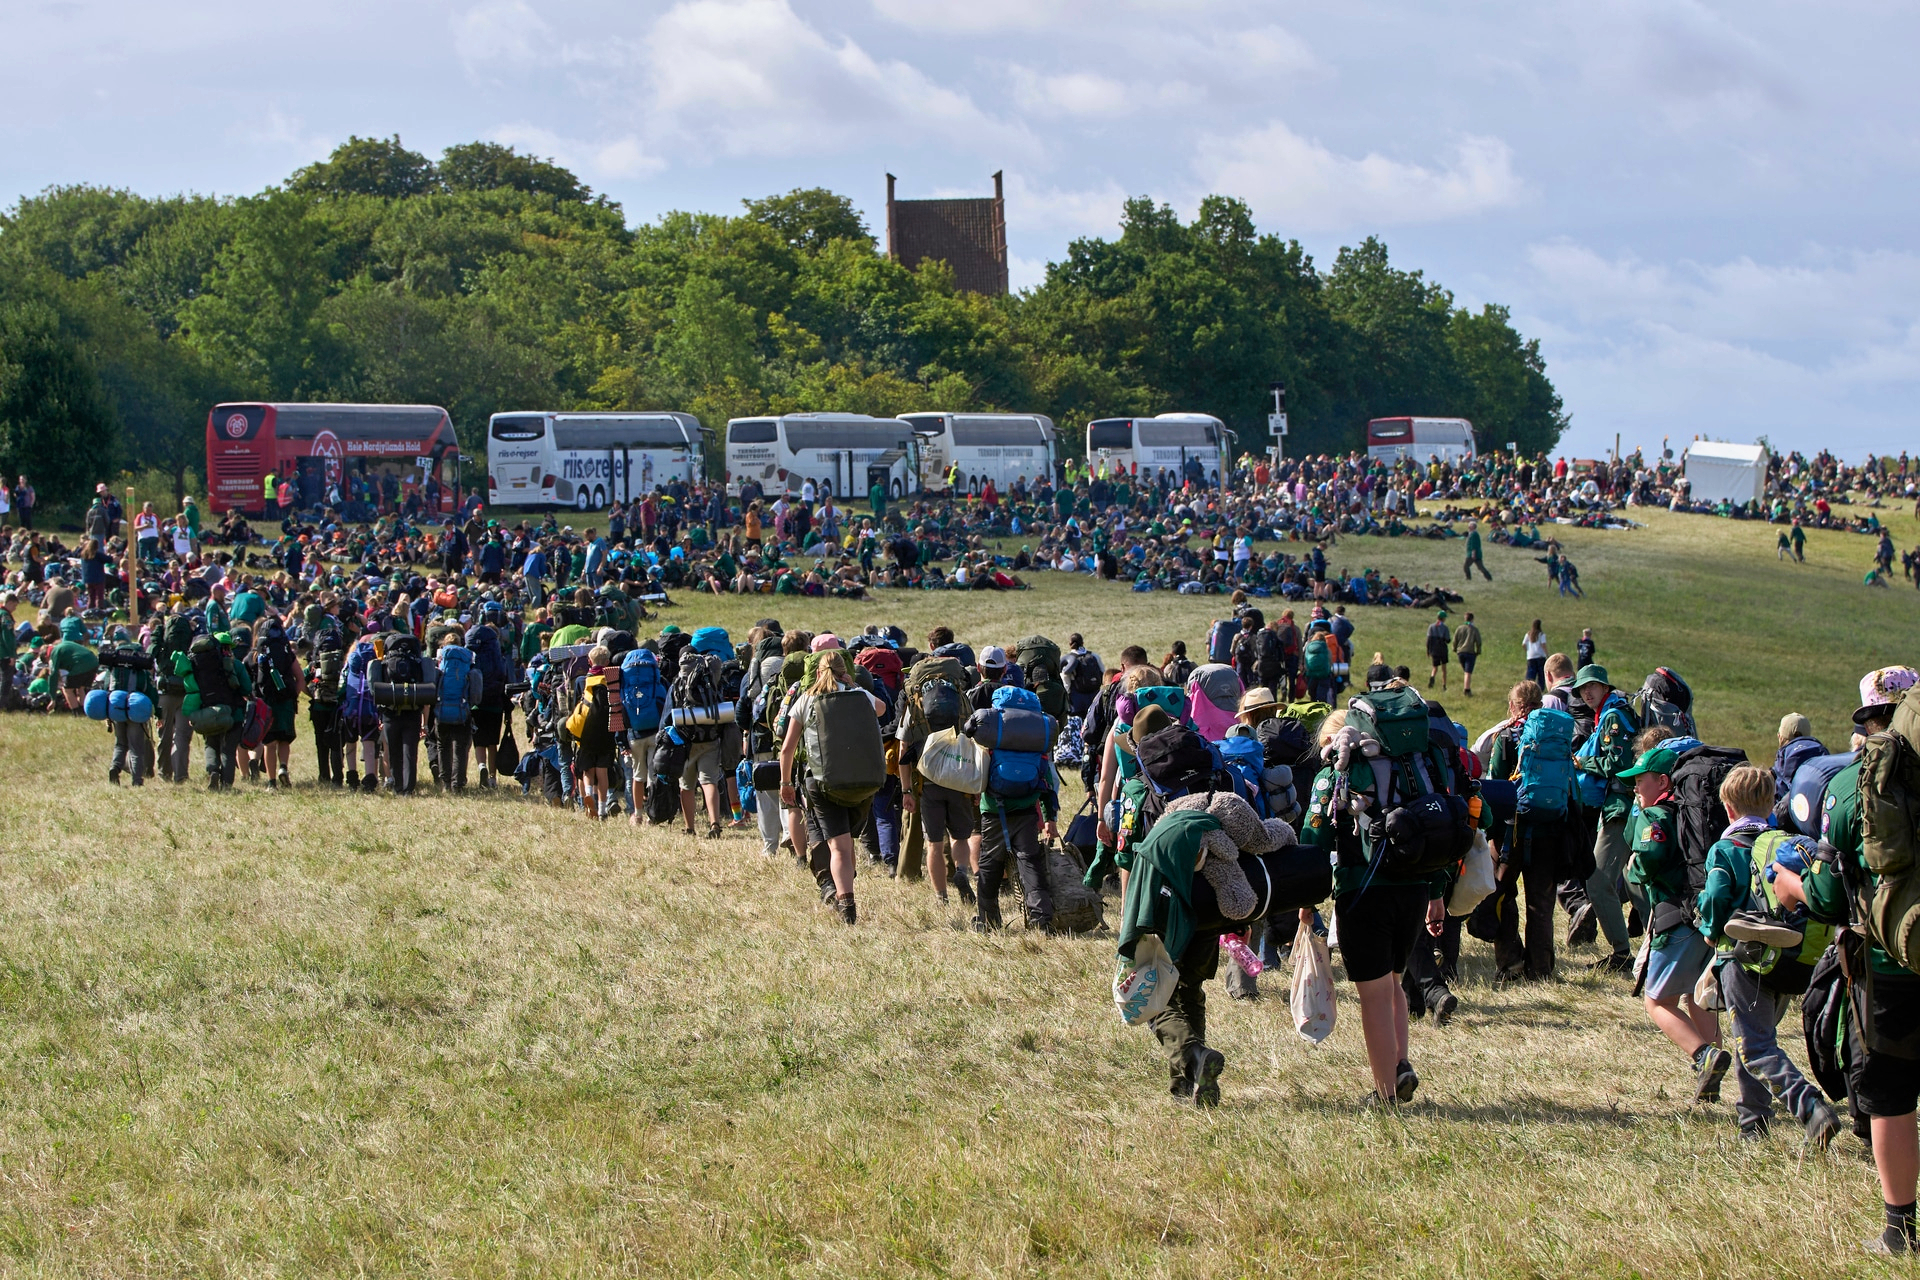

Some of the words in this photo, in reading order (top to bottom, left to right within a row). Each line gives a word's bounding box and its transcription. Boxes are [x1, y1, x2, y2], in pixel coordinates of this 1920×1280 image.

[347, 441, 362, 451] Hele
[363, 441, 404, 454] Nordjyllands
[405, 441, 420, 451] Hold
[515, 448, 538, 459] rejser
